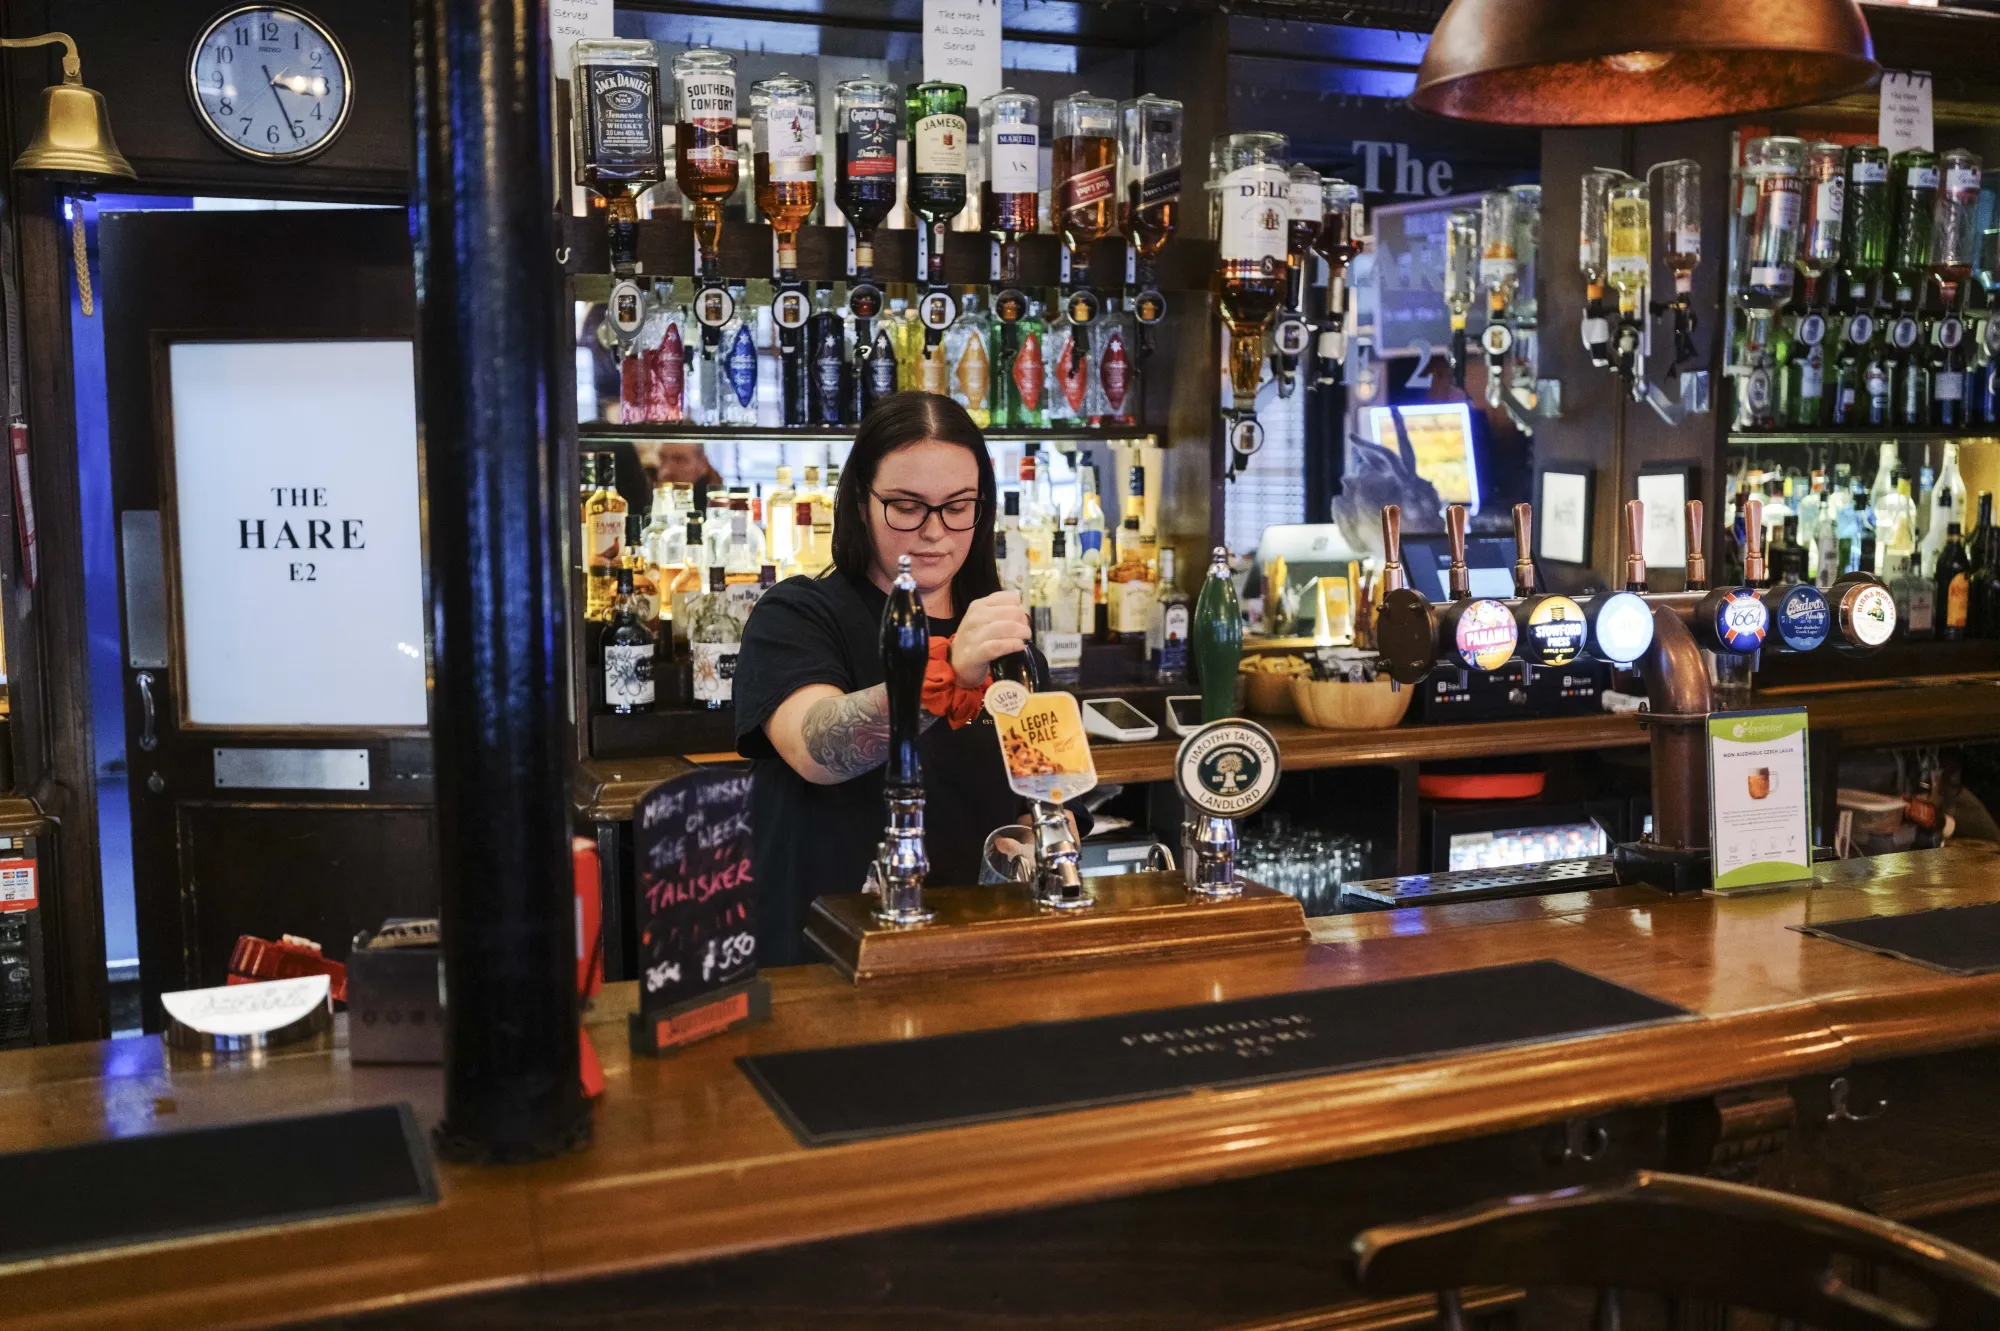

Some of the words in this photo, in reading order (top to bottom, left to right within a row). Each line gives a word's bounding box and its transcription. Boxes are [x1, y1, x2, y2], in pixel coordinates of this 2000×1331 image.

[553, 9, 588, 20] Served
[939, 10, 955, 19] The
[958, 12, 980, 21] Hare
[235, 27, 249, 46] 11
[260, 22, 279, 41] 12
[557, 26, 586, 37] 35ml
[934, 25, 949, 34] All
[951, 26, 985, 37] Spirits
[293, 32, 300, 50] 1
[943, 42, 976, 51] Served
[215, 46, 233, 64] 10
[309, 51, 322, 70] 2
[946, 58, 973, 66] 35ml
[211, 71, 224, 89] 9
[594, 77, 617, 95] JACK
[616, 73, 653, 96] DANIEL'S
[687, 83, 735, 99] SOUTHERN
[220, 97, 233, 116] 8
[310, 102, 323, 120] 4
[691, 98, 733, 111] COMFORT
[605, 109, 644, 119] Tennessee
[770, 108, 796, 121] Captain
[850, 108, 877, 122] Captain
[240, 117, 253, 136] 7
[293, 120, 305, 138] 5
[923, 117, 965, 132] JAMESON
[267, 125, 280, 144] 6
[999, 134, 1035, 145] MARTELL
[1011, 160, 1028, 172] VS
[1352, 140, 1453, 197] The
[1767, 179, 1801, 193] SMIRN
[270, 487, 328, 507] THE
[237, 518, 367, 550] HARE
[289, 562, 317, 581] E2
[1786, 598, 1825, 619] Budvar
[1731, 610, 1762, 627] 1664
[1466, 627, 1511, 647] PANAMA
[1535, 623, 1582, 639] STOWFORD
[1547, 636, 1571, 648] PRESS
[994, 691, 1018, 704] LEIGH
[1020, 711, 1059, 732] LEGRA
[1028, 725, 1059, 745] PALE
[1188, 731, 1231, 765] TIMOTHY
[1234, 731, 1272, 764] TAYLOR'S
[1199, 788, 1261, 810] LANDLORD
[643, 790, 688, 829] MALT
[697, 811, 753, 849] WEEK
[645, 858, 754, 915] TALISKER
